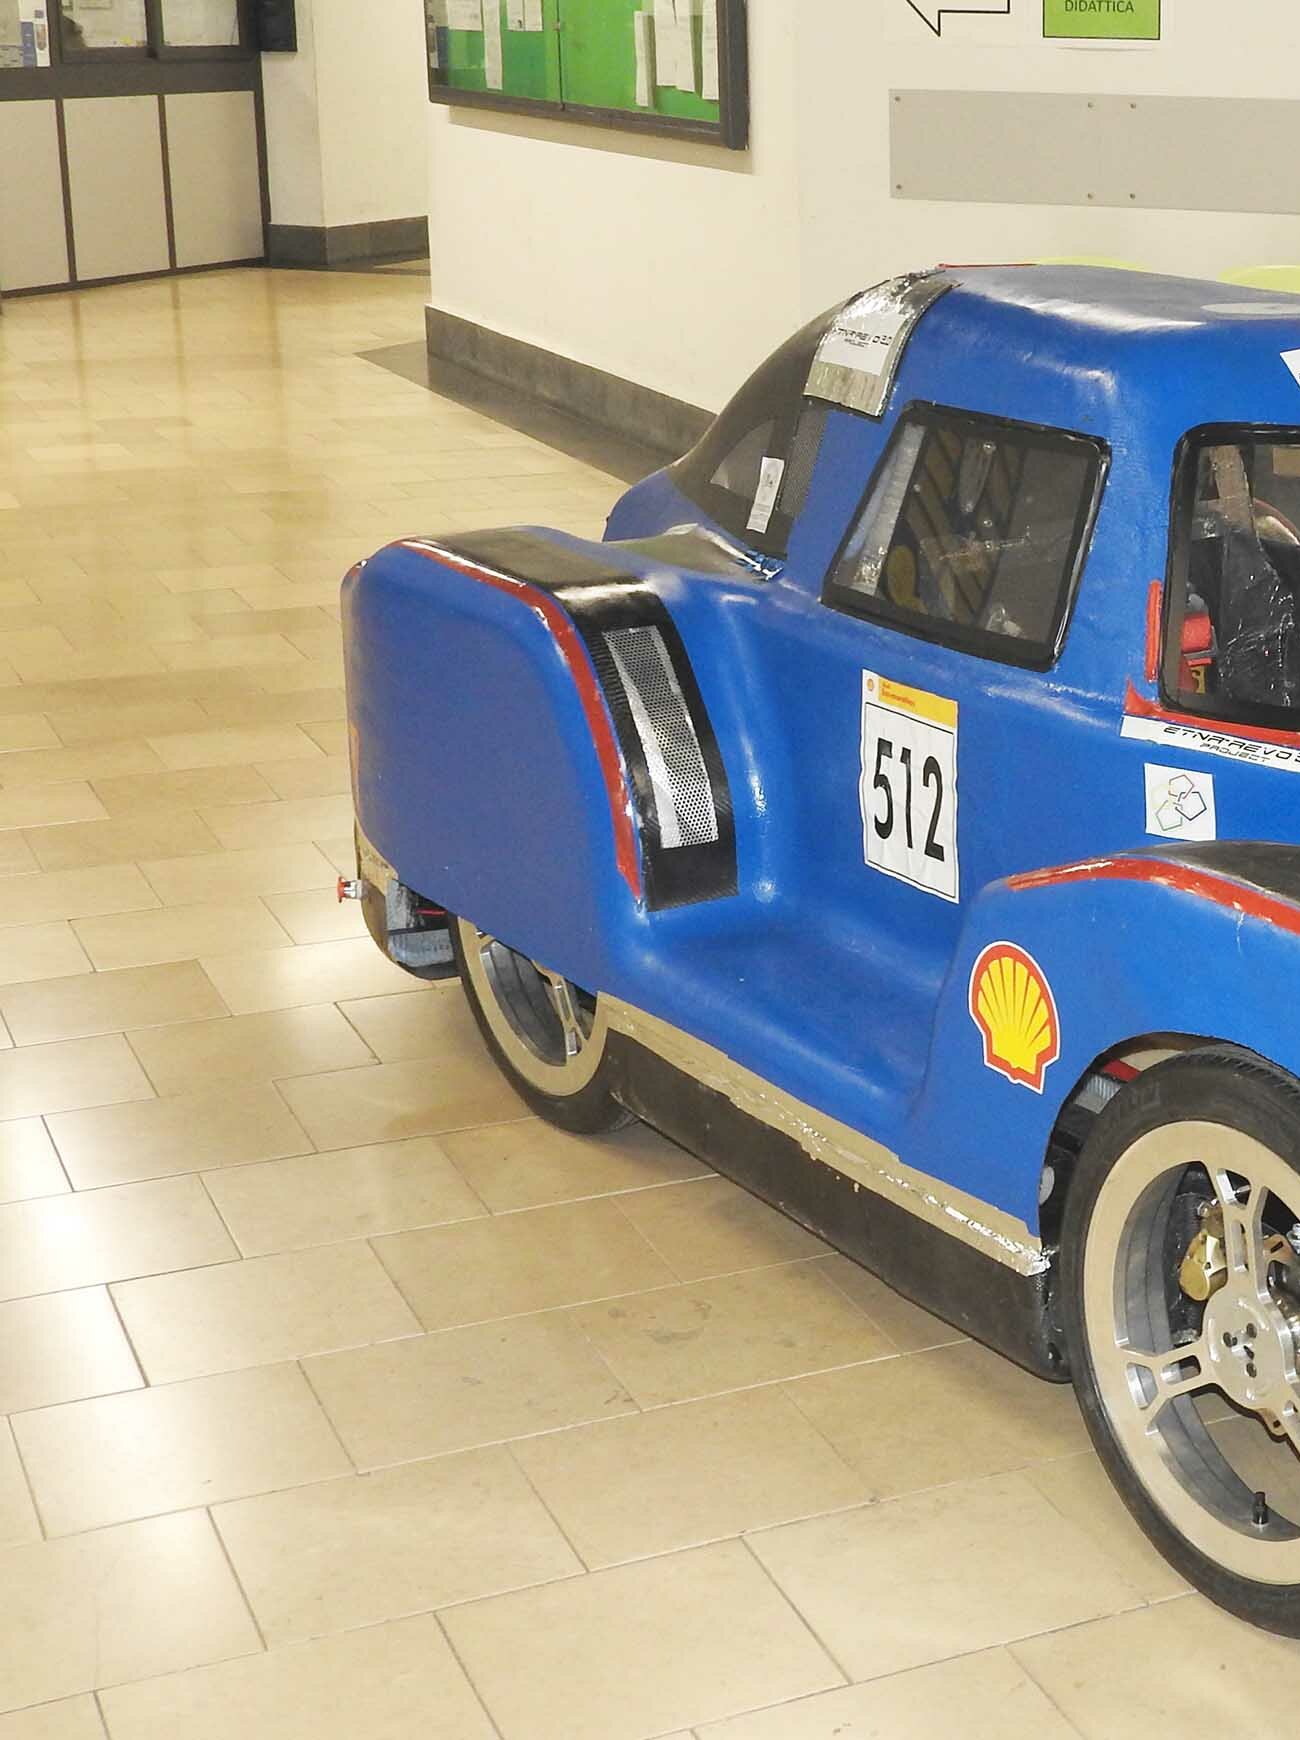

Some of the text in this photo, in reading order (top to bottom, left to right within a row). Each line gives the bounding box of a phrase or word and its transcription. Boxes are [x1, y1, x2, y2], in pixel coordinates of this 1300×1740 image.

[1065, 0, 1134, 13] DIDATTICA
[1199, 742, 1270, 763] PROJECT
[874, 737, 945, 862] 512
